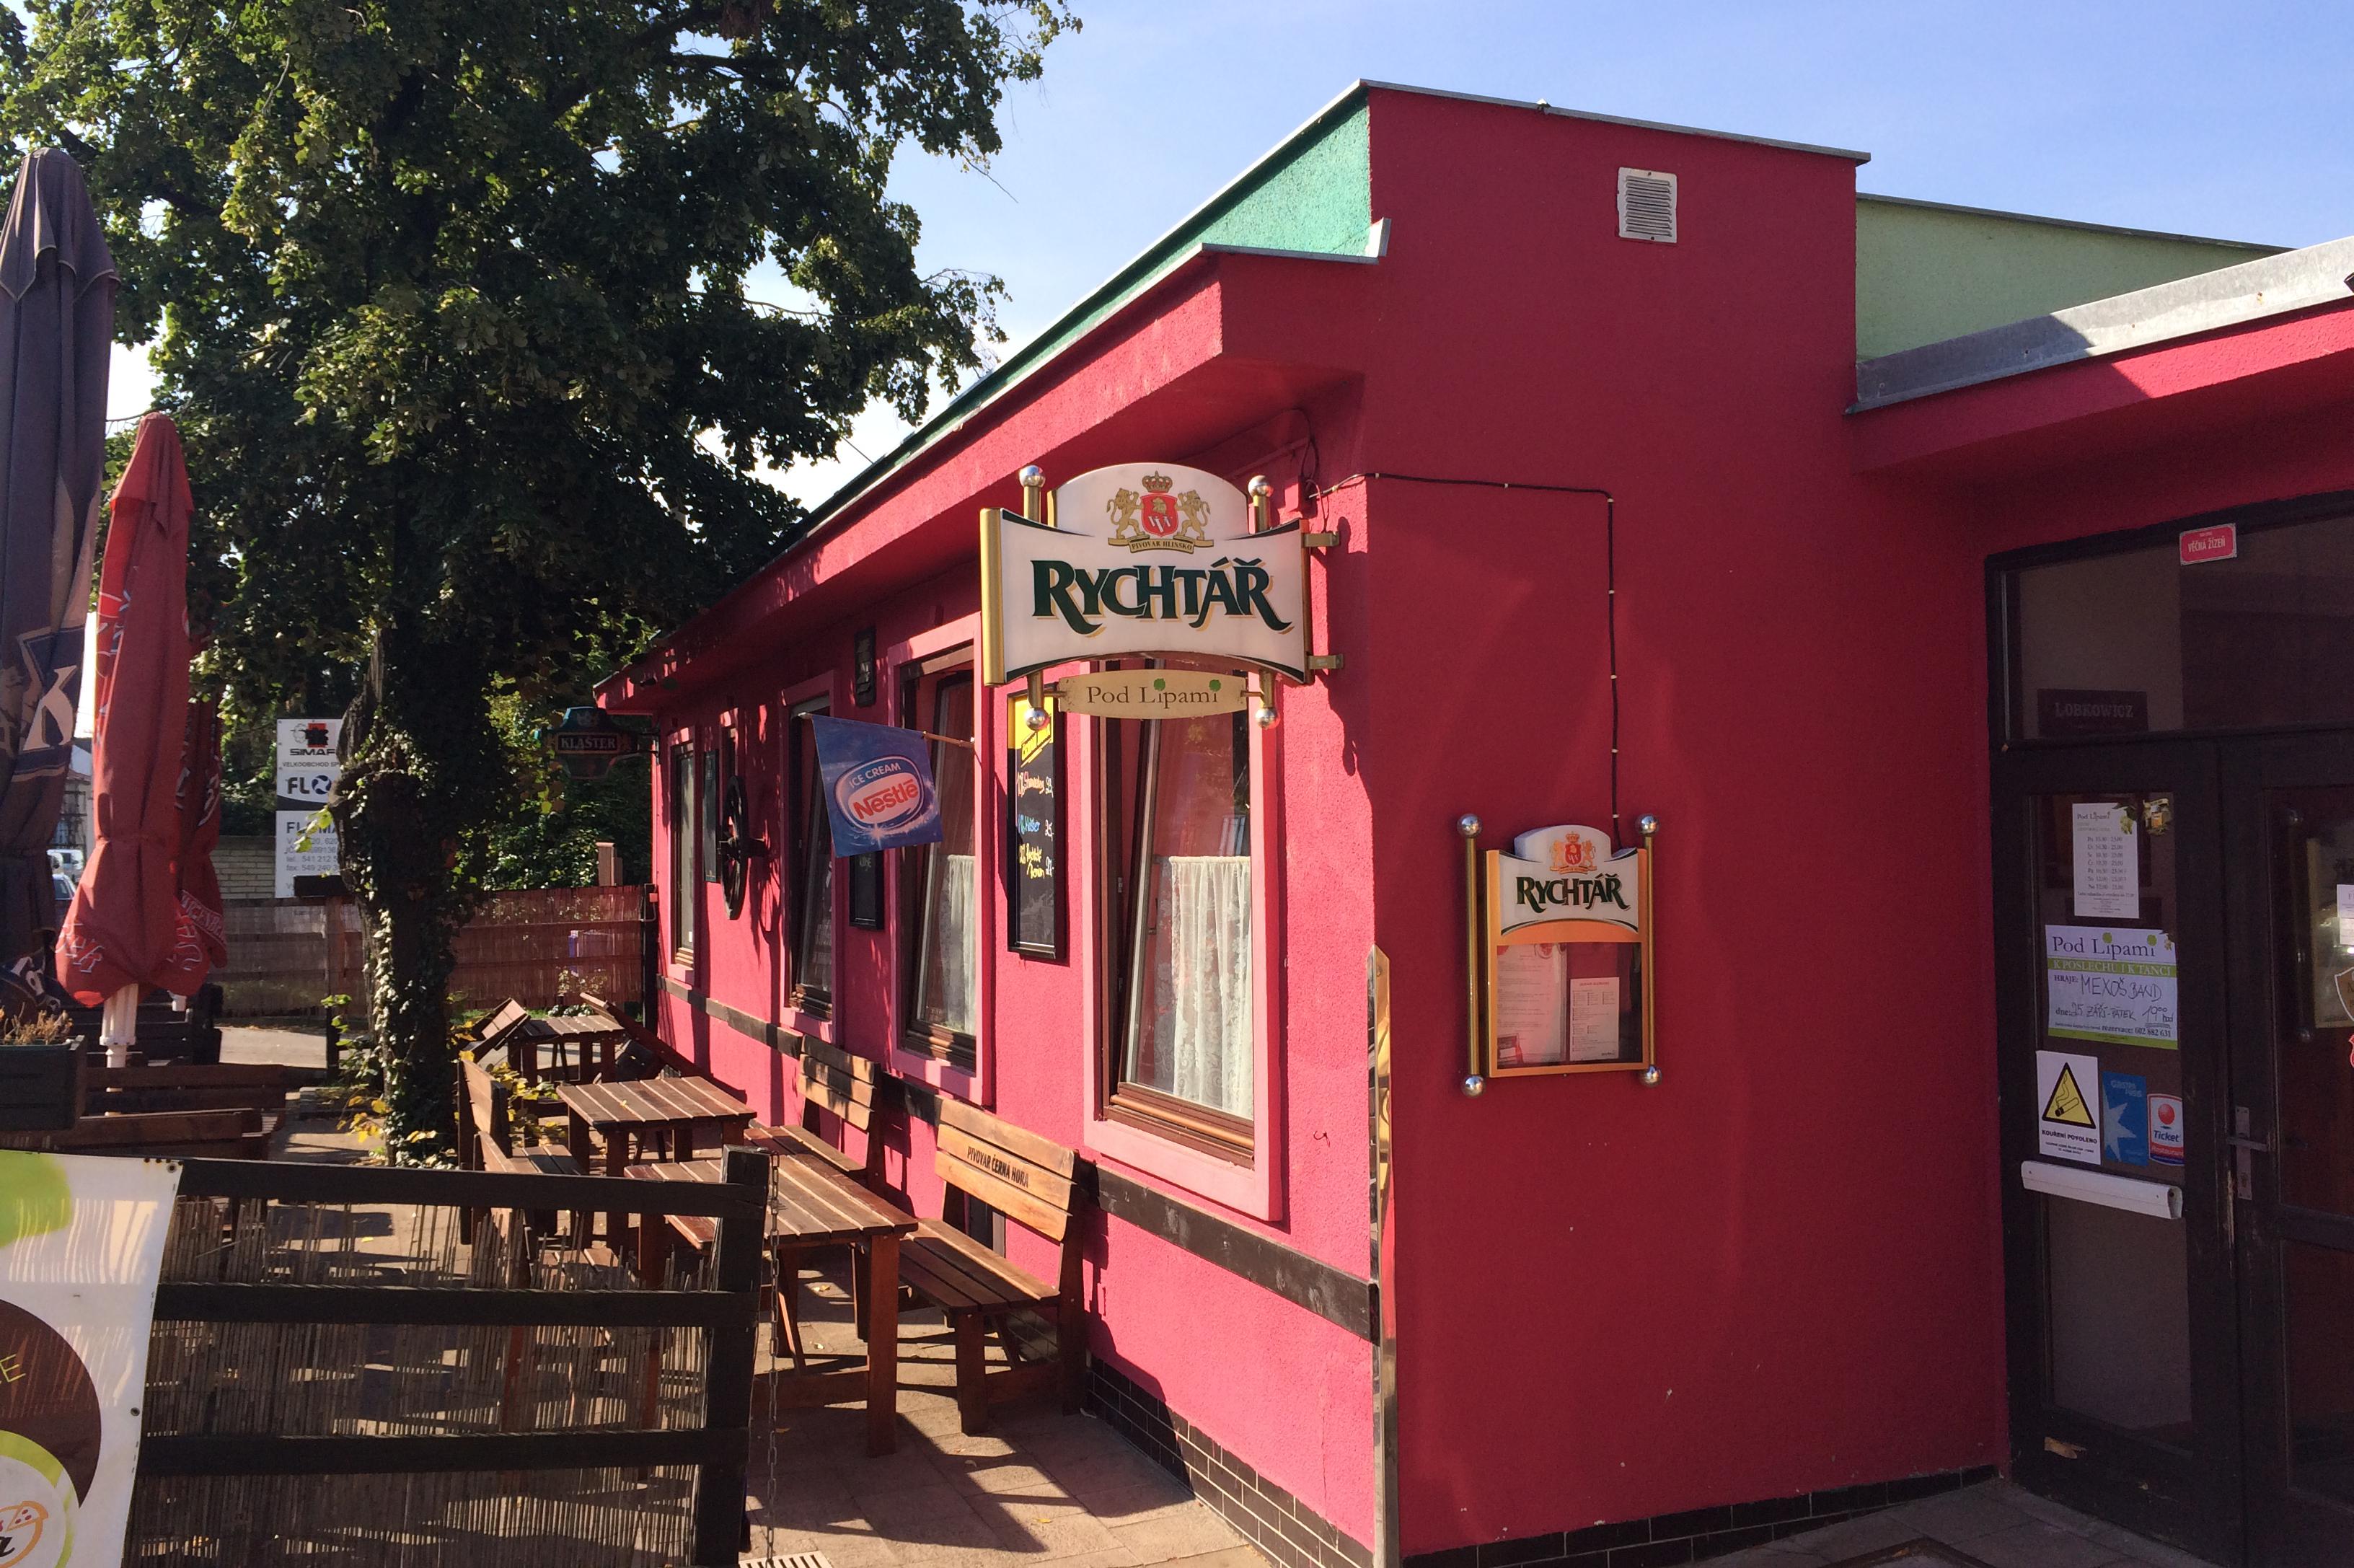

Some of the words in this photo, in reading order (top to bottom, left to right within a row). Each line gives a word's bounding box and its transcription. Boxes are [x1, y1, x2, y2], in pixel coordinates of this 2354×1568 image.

[1163, 541, 1192, 550] HLINSKO
[1031, 556, 1295, 638] RYCHTÁŘ
[1087, 686, 1129, 703] Pod
[1139, 679, 1220, 708] Lipami
[849, 773, 864, 788] ICE
[865, 762, 901, 780] CREAM
[852, 779, 919, 820] Nestlé
[1516, 873, 1631, 913] RYCHTÁŘ
[2053, 936, 2084, 953] Pod
[2091, 933, 2157, 960] Lipami
[2054, 960, 2062, 969] K
[2062, 960, 2119, 972] POSLECHU
[2128, 964, 2135, 974] K
[2042, 1129, 2067, 1140] KOUŘENÍ
[2067, 1134, 2098, 1144] POVOLENO
[2153, 1130, 2180, 1142] Ticket
[967, 1146, 992, 1169] PIVOVAR
[1011, 1166, 1028, 1188] HORA
